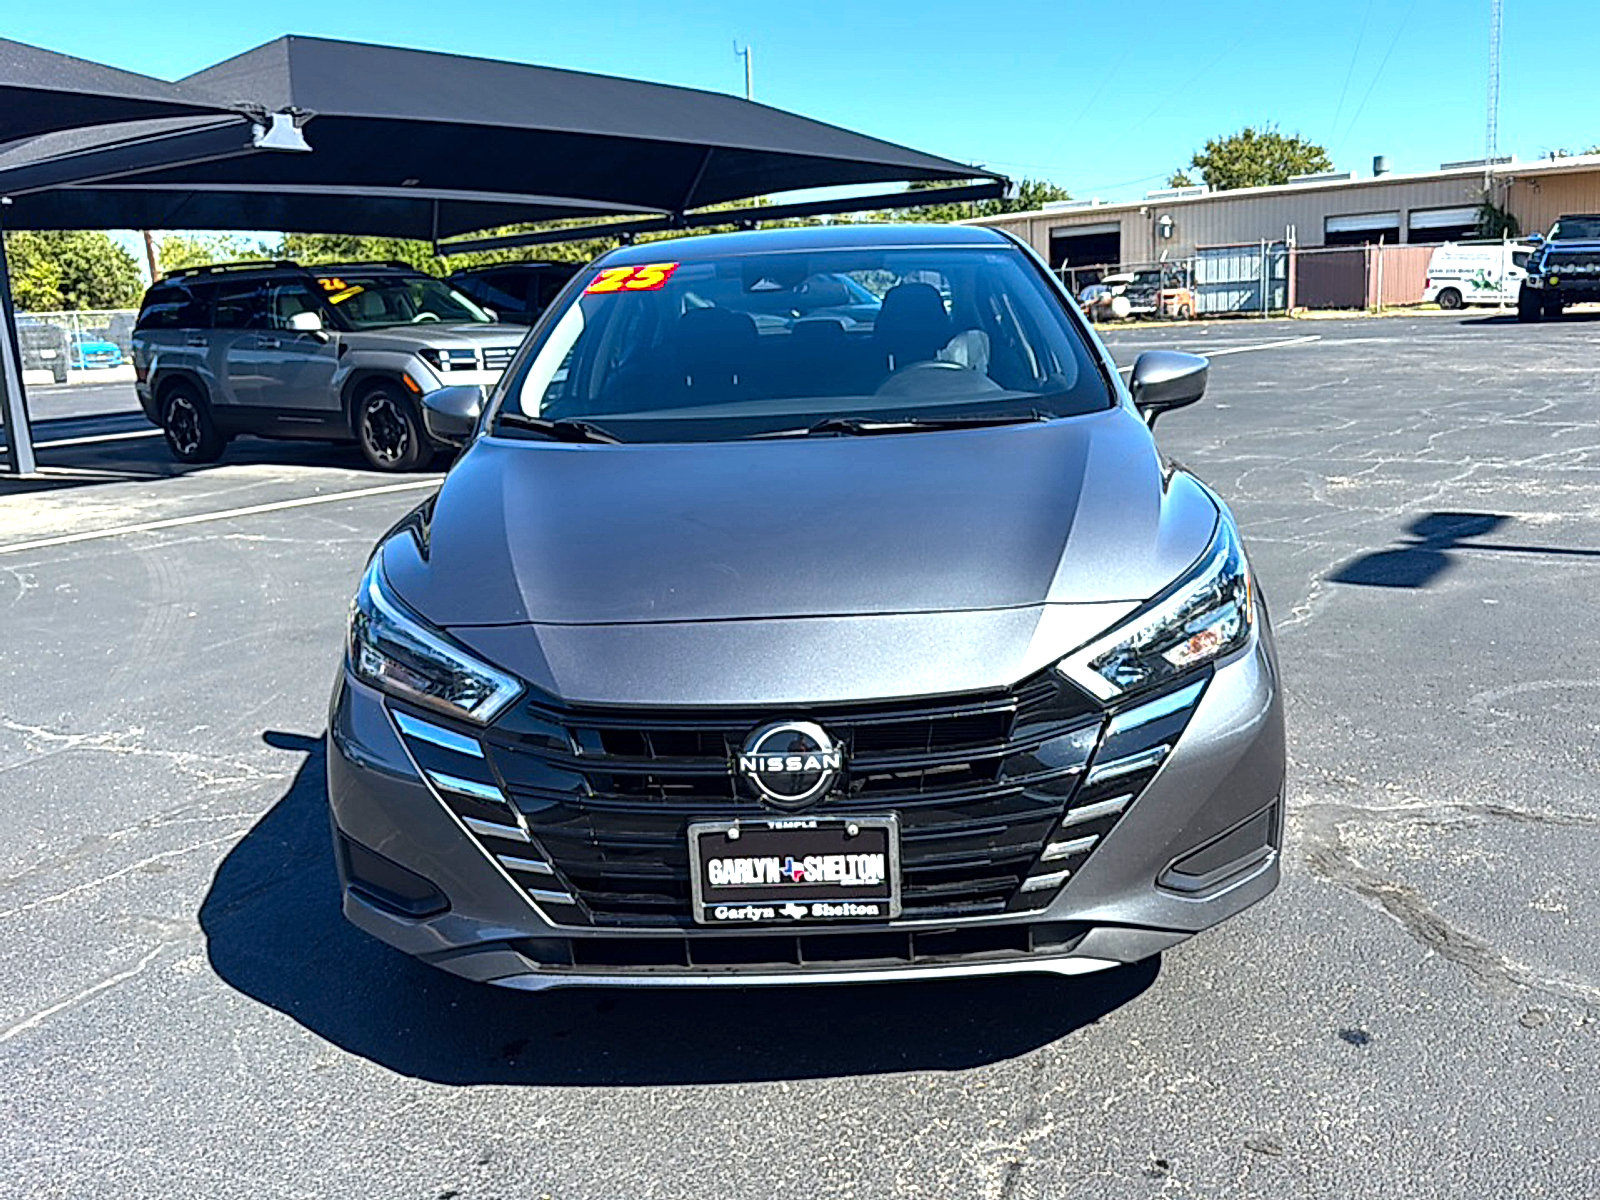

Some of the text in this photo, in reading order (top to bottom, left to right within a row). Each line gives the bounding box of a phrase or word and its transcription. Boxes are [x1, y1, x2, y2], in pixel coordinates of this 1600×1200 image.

[317, 277, 347, 291] 26
[586, 262, 675, 292] 25
[739, 754, 840, 772] NISSAN
[767, 820, 817, 830] TEMPLE
[708, 853, 885, 885] GARLYN SHELTON
[714, 903, 879, 921] Garlyn Shelton
